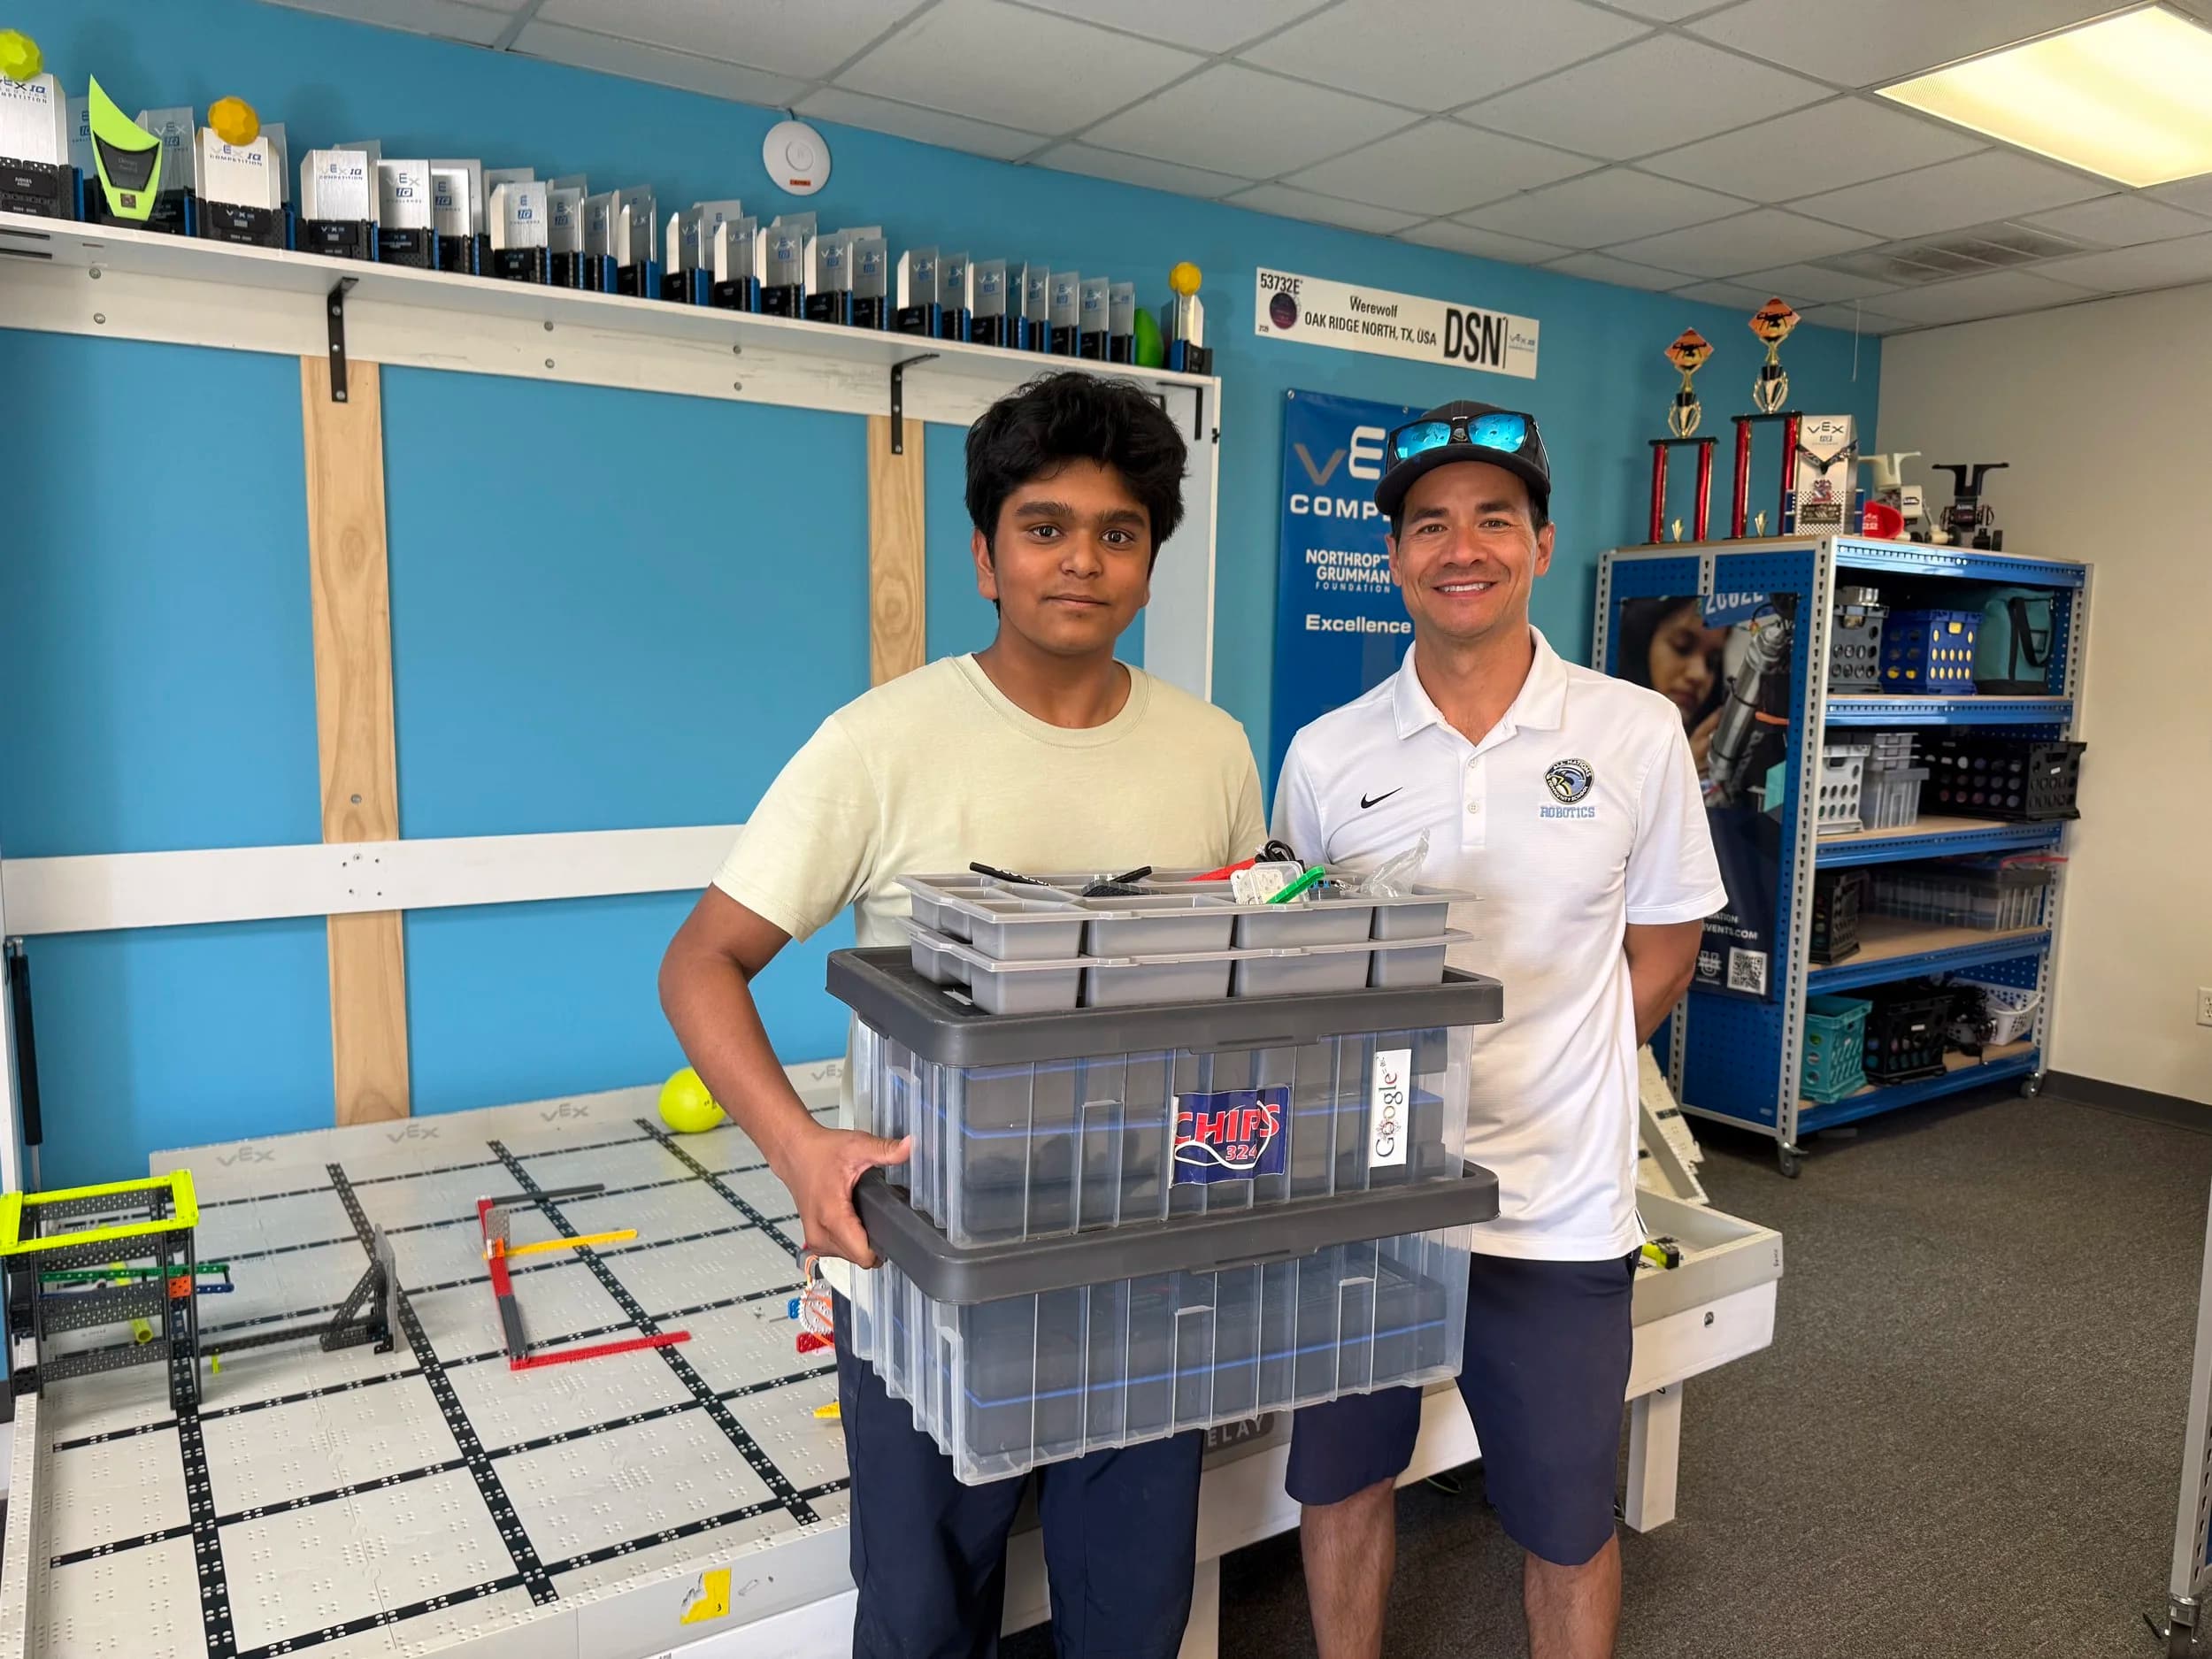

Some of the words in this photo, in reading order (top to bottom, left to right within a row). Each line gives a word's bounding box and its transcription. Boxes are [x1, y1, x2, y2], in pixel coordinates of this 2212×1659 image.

[1260, 273, 1300, 295] 53732E
[1349, 296, 1398, 318] Werewolf
[1304, 311, 1327, 328] OAK
[1329, 316, 1359, 334] RIDGE
[1362, 321, 1398, 341] NORTH,
[1401, 327, 1414, 343] TX,
[1417, 328, 1437, 346] USA
[1443, 307, 1502, 367] DSN
[1807, 421, 1845, 434] VEX
[1293, 425, 1386, 487] VE
[1290, 494, 1391, 522] COMP
[1305, 549, 1381, 567] NORTHROP
[1316, 565, 1390, 584] GRUMMAN
[1316, 581, 1390, 594] FOUNDATION
[1305, 613, 1411, 634] Excellence
[1567, 759, 1592, 778] NATIONS
[1540, 805, 1596, 819] ROBOTICS
[541, 1102, 589, 1123] VEX
[1375, 1071, 1403, 1157] Google
[385, 1124, 440, 1144] VEX
[1175, 1102, 1281, 1145] CHIPS
[215, 1146, 276, 1168] VEX
[1225, 1144, 1258, 1162] 324
[1207, 1416, 1263, 1448] ELAY
